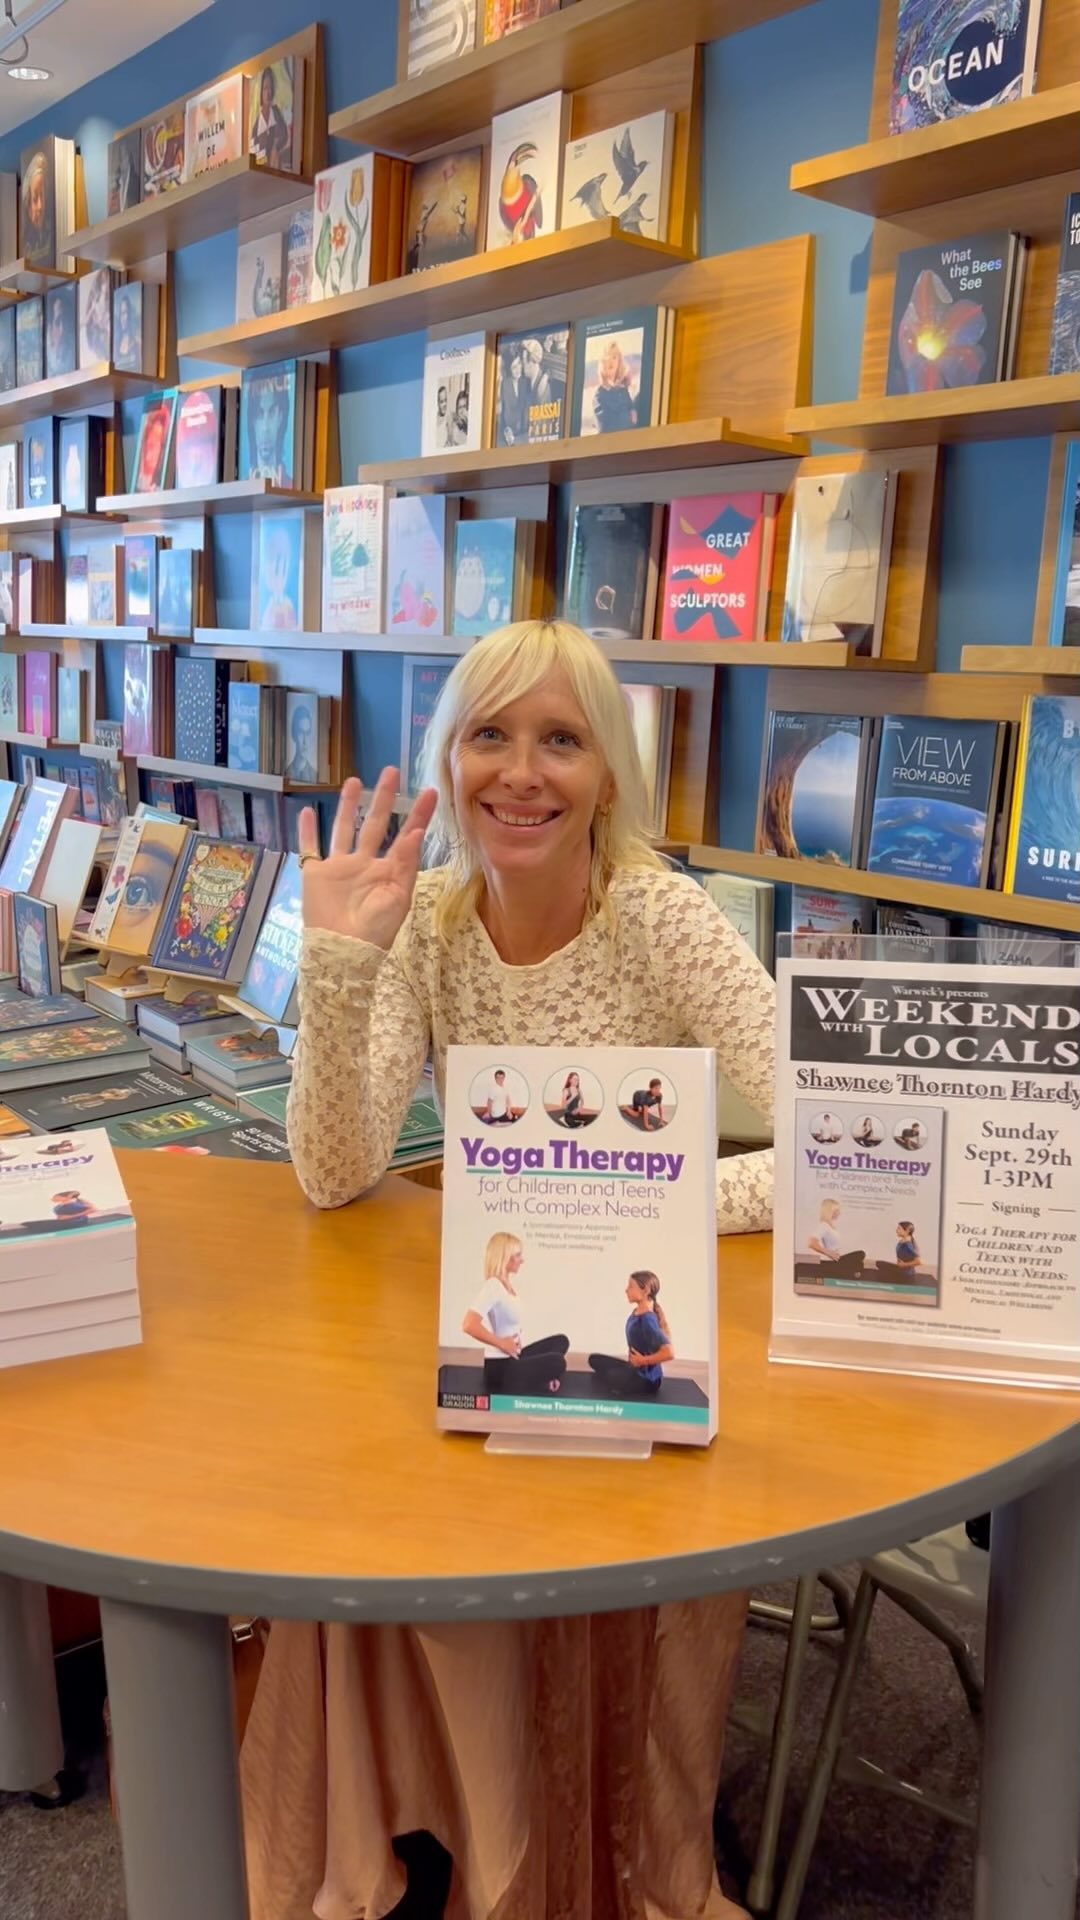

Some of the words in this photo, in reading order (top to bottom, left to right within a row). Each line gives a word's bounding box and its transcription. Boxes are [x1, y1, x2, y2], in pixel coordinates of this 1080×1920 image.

[908, 38, 1005, 92] OCEAN
[198, 119, 225, 143] WILLEM
[206, 145, 216, 157] DE
[941, 248, 971, 265] What
[950, 263, 969, 279] the
[972, 258, 1002, 274] Bees
[959, 277, 982, 291] See
[706, 531, 750, 549] GREAT
[669, 592, 746, 609] SCULPTORS
[897, 735, 976, 770] VIEW
[893, 767, 927, 783] FROM
[928, 770, 972, 786] ABOVE
[18, 799, 57, 884] PETAL
[892, 984, 944, 998] Warwick's
[946, 988, 988, 999] presents
[801, 986, 1080, 1030] WEEKEND
[820, 1021, 864, 1033] WITH
[864, 1024, 1080, 1067] LOCALS
[796, 1068, 893, 1093] Shawnee
[896, 1073, 1008, 1100] Thornton
[1011, 1080, 1080, 1110] Hardy
[193, 1101, 243, 1124] WRIGHT
[981, 1120, 1059, 1146] Sunday
[460, 1137, 545, 1175] Yoga
[549, 1139, 685, 1182] Therapy
[805, 1149, 852, 1170] Yoga
[854, 1152, 932, 1176] Therapy
[965, 1143, 1018, 1167] Sept.
[1025, 1148, 1072, 1167] 29th
[478, 1176, 502, 1196] for
[506, 1177, 576, 1196] Children
[581, 1180, 614, 1197] and
[620, 1181, 666, 1199] Teens
[984, 1169, 1053, 1189] 1-3PM
[484, 1197, 520, 1213] with
[524, 1198, 601, 1218] Complex
[605, 1201, 661, 1219] Needs
[992, 1201, 1041, 1218] Signing
[955, 1223, 987, 1236] YOGA
[991, 1226, 1049, 1240] THERAPY
[1050, 1232, 1077, 1242] FOR
[967, 1237, 1033, 1252] CHILDREN
[1035, 1245, 1063, 1254] AND
[976, 1250, 1016, 1264] TEENS
[1018, 1257, 1053, 1267] WITH
[959, 1262, 1020, 1277] COMPLEX
[1021, 1267, 1068, 1281] NEEDS:
[514, 1399, 552, 1411] Shawnee
[554, 1401, 593, 1413] Thornton
[594, 1404, 624, 1417] Hardy
